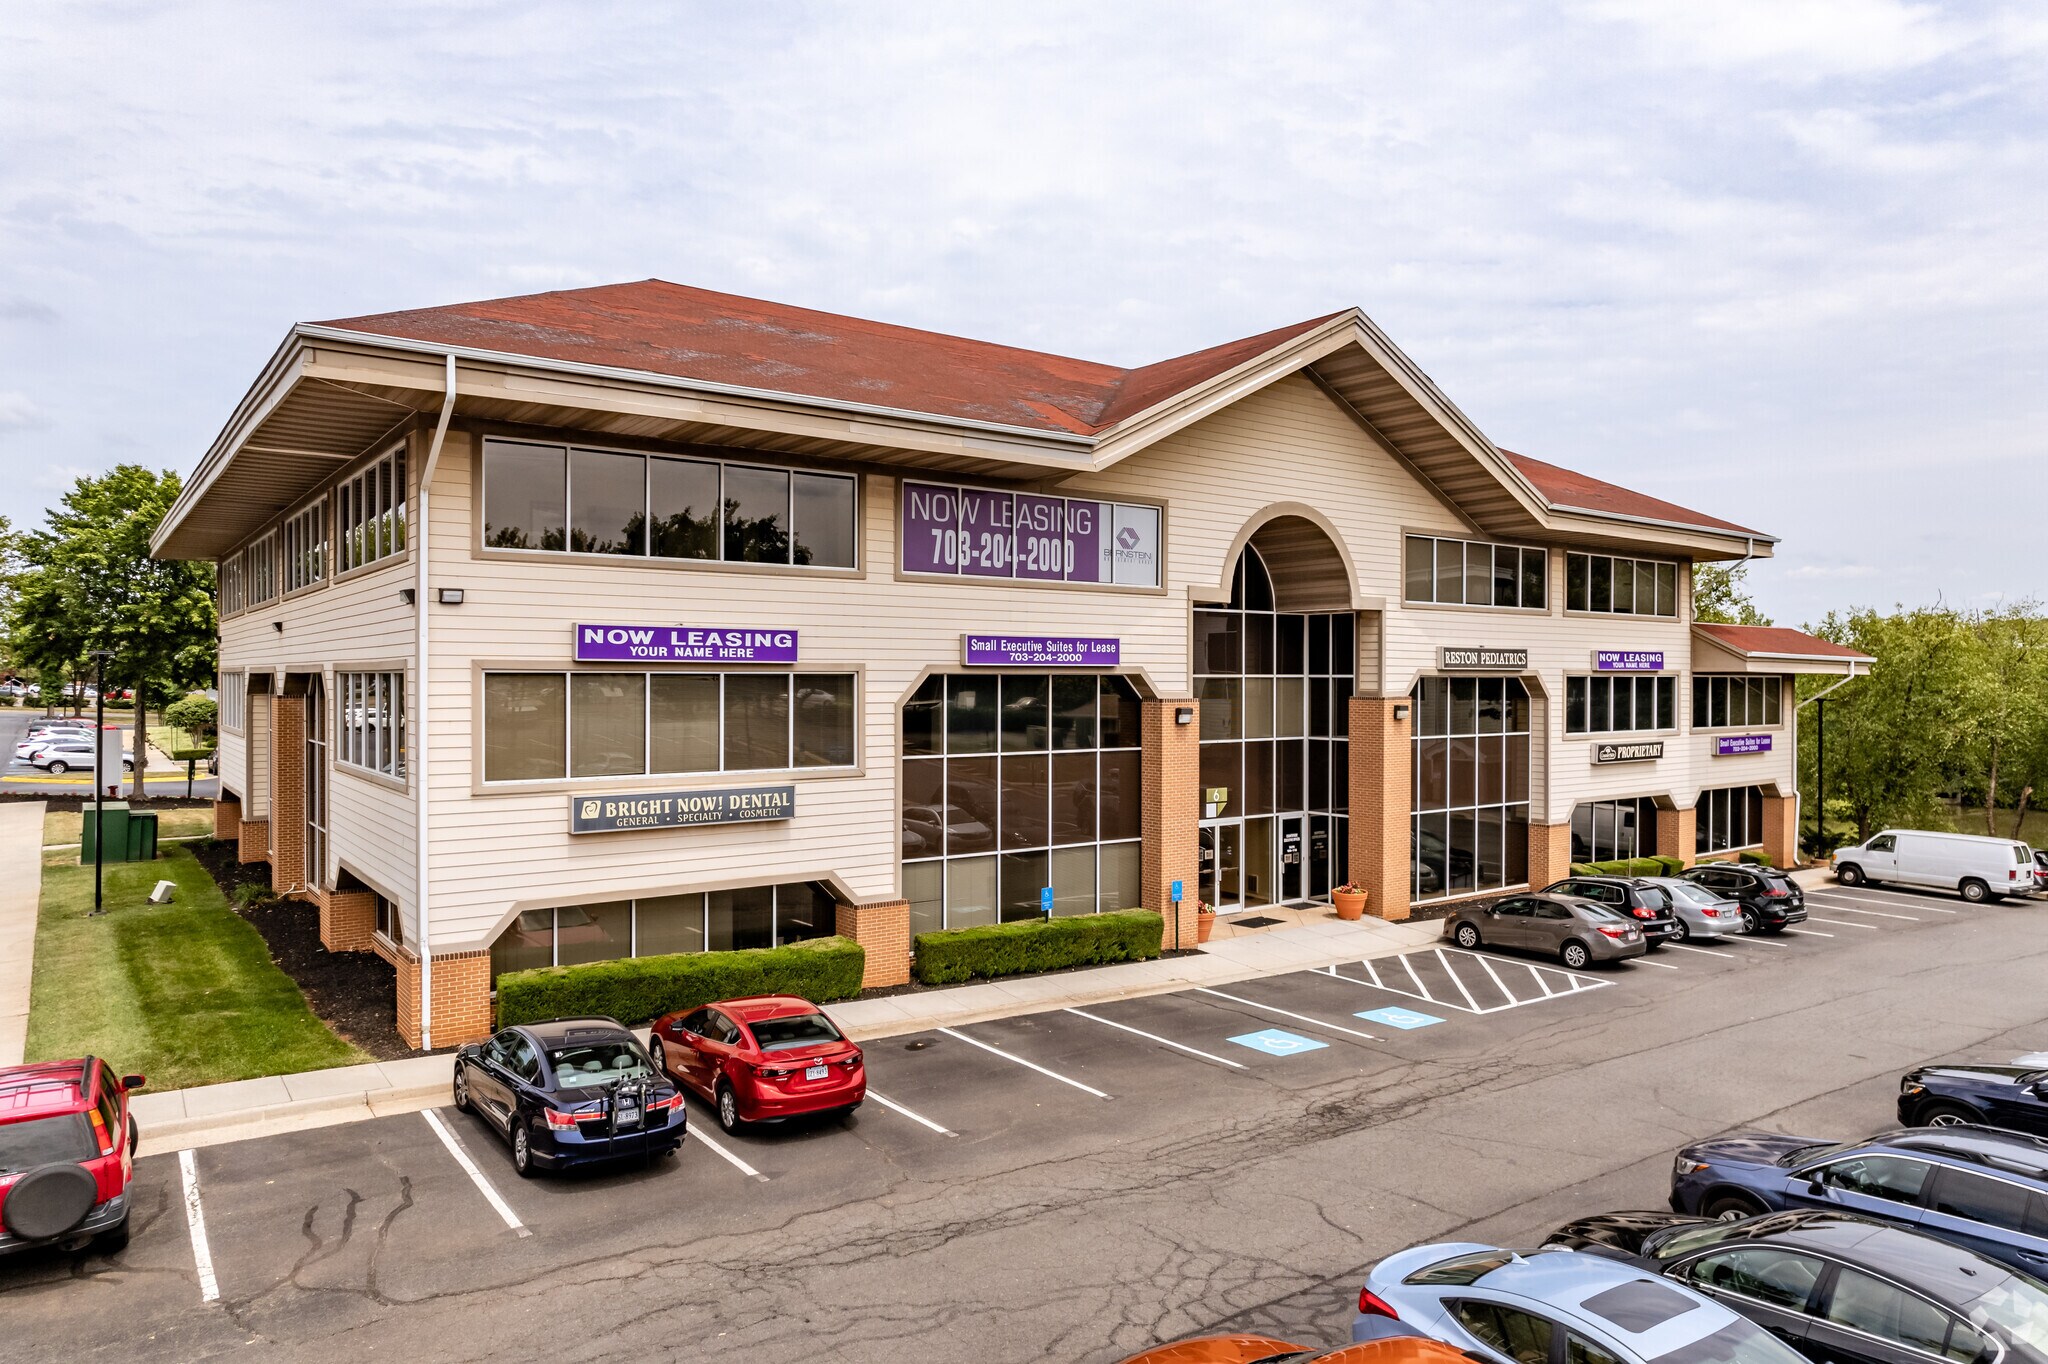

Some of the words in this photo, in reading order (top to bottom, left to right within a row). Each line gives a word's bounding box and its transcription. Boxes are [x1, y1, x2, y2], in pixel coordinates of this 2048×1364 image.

[910, 491, 980, 525] NOW
[990, 501, 1092, 535] LEASING
[931, 528, 1075, 573] 703-204-2000
[1103, 548, 1152, 560] BRNSTEIN
[584, 629, 654, 645] NOW
[670, 631, 793, 648] LEASING
[971, 638, 997, 651] Small
[1001, 640, 1043, 652] Executive
[1046, 640, 1073, 653] Suites
[1076, 641, 1088, 653] for
[1091, 642, 1116, 653] Lease
[630, 646, 668, 657] YOUR
[675, 647, 713, 658] NAME
[719, 648, 754, 658] HERE
[1009, 652, 1083, 662] 703-204-2000
[1445, 651, 1478, 664] RESTON
[1480, 652, 1526, 664] PEDIATRICS
[1599, 653, 1620, 662] NOW
[1624, 653, 1662, 663] LEASING
[1617, 744, 1662, 759] PROPRIETARY
[1214, 788, 1220, 801] 6
[605, 799, 673, 818] BRIGHT
[677, 796, 723, 813] NOW!
[729, 792, 790, 810] DENTAL
[616, 817, 659, 828] GENERAL
[677, 811, 723, 823] SPECIALTY
[739, 807, 781, 819] COSMETIC
